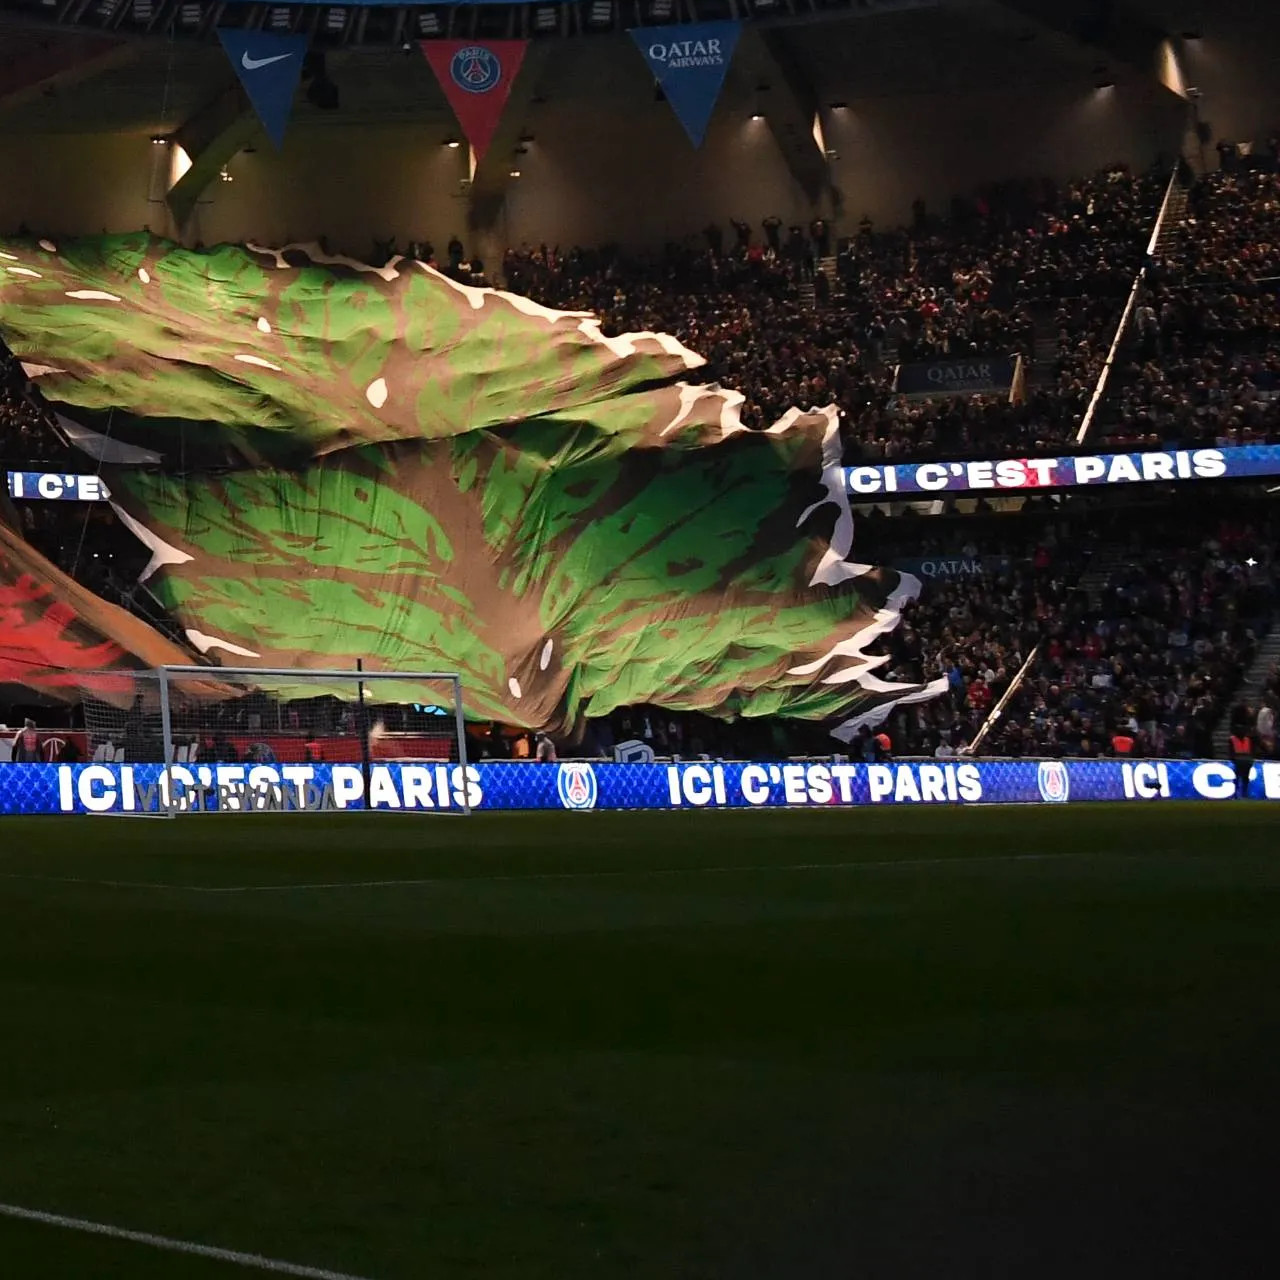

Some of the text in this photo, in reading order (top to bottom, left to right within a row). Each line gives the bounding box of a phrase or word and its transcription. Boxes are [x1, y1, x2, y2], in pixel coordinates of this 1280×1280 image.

[649, 38, 721, 61] QATAR
[668, 55, 723, 68] AIRWAYS
[927, 364, 991, 383] QATAR
[842, 450, 1226, 493] CI C'EST PARIS
[921, 559, 982, 578] QATAR
[58, 765, 483, 811] ICI C'EST PARIS
[667, 764, 982, 805] ICI C'EST PARIS
[1122, 763, 1170, 798] ICI
